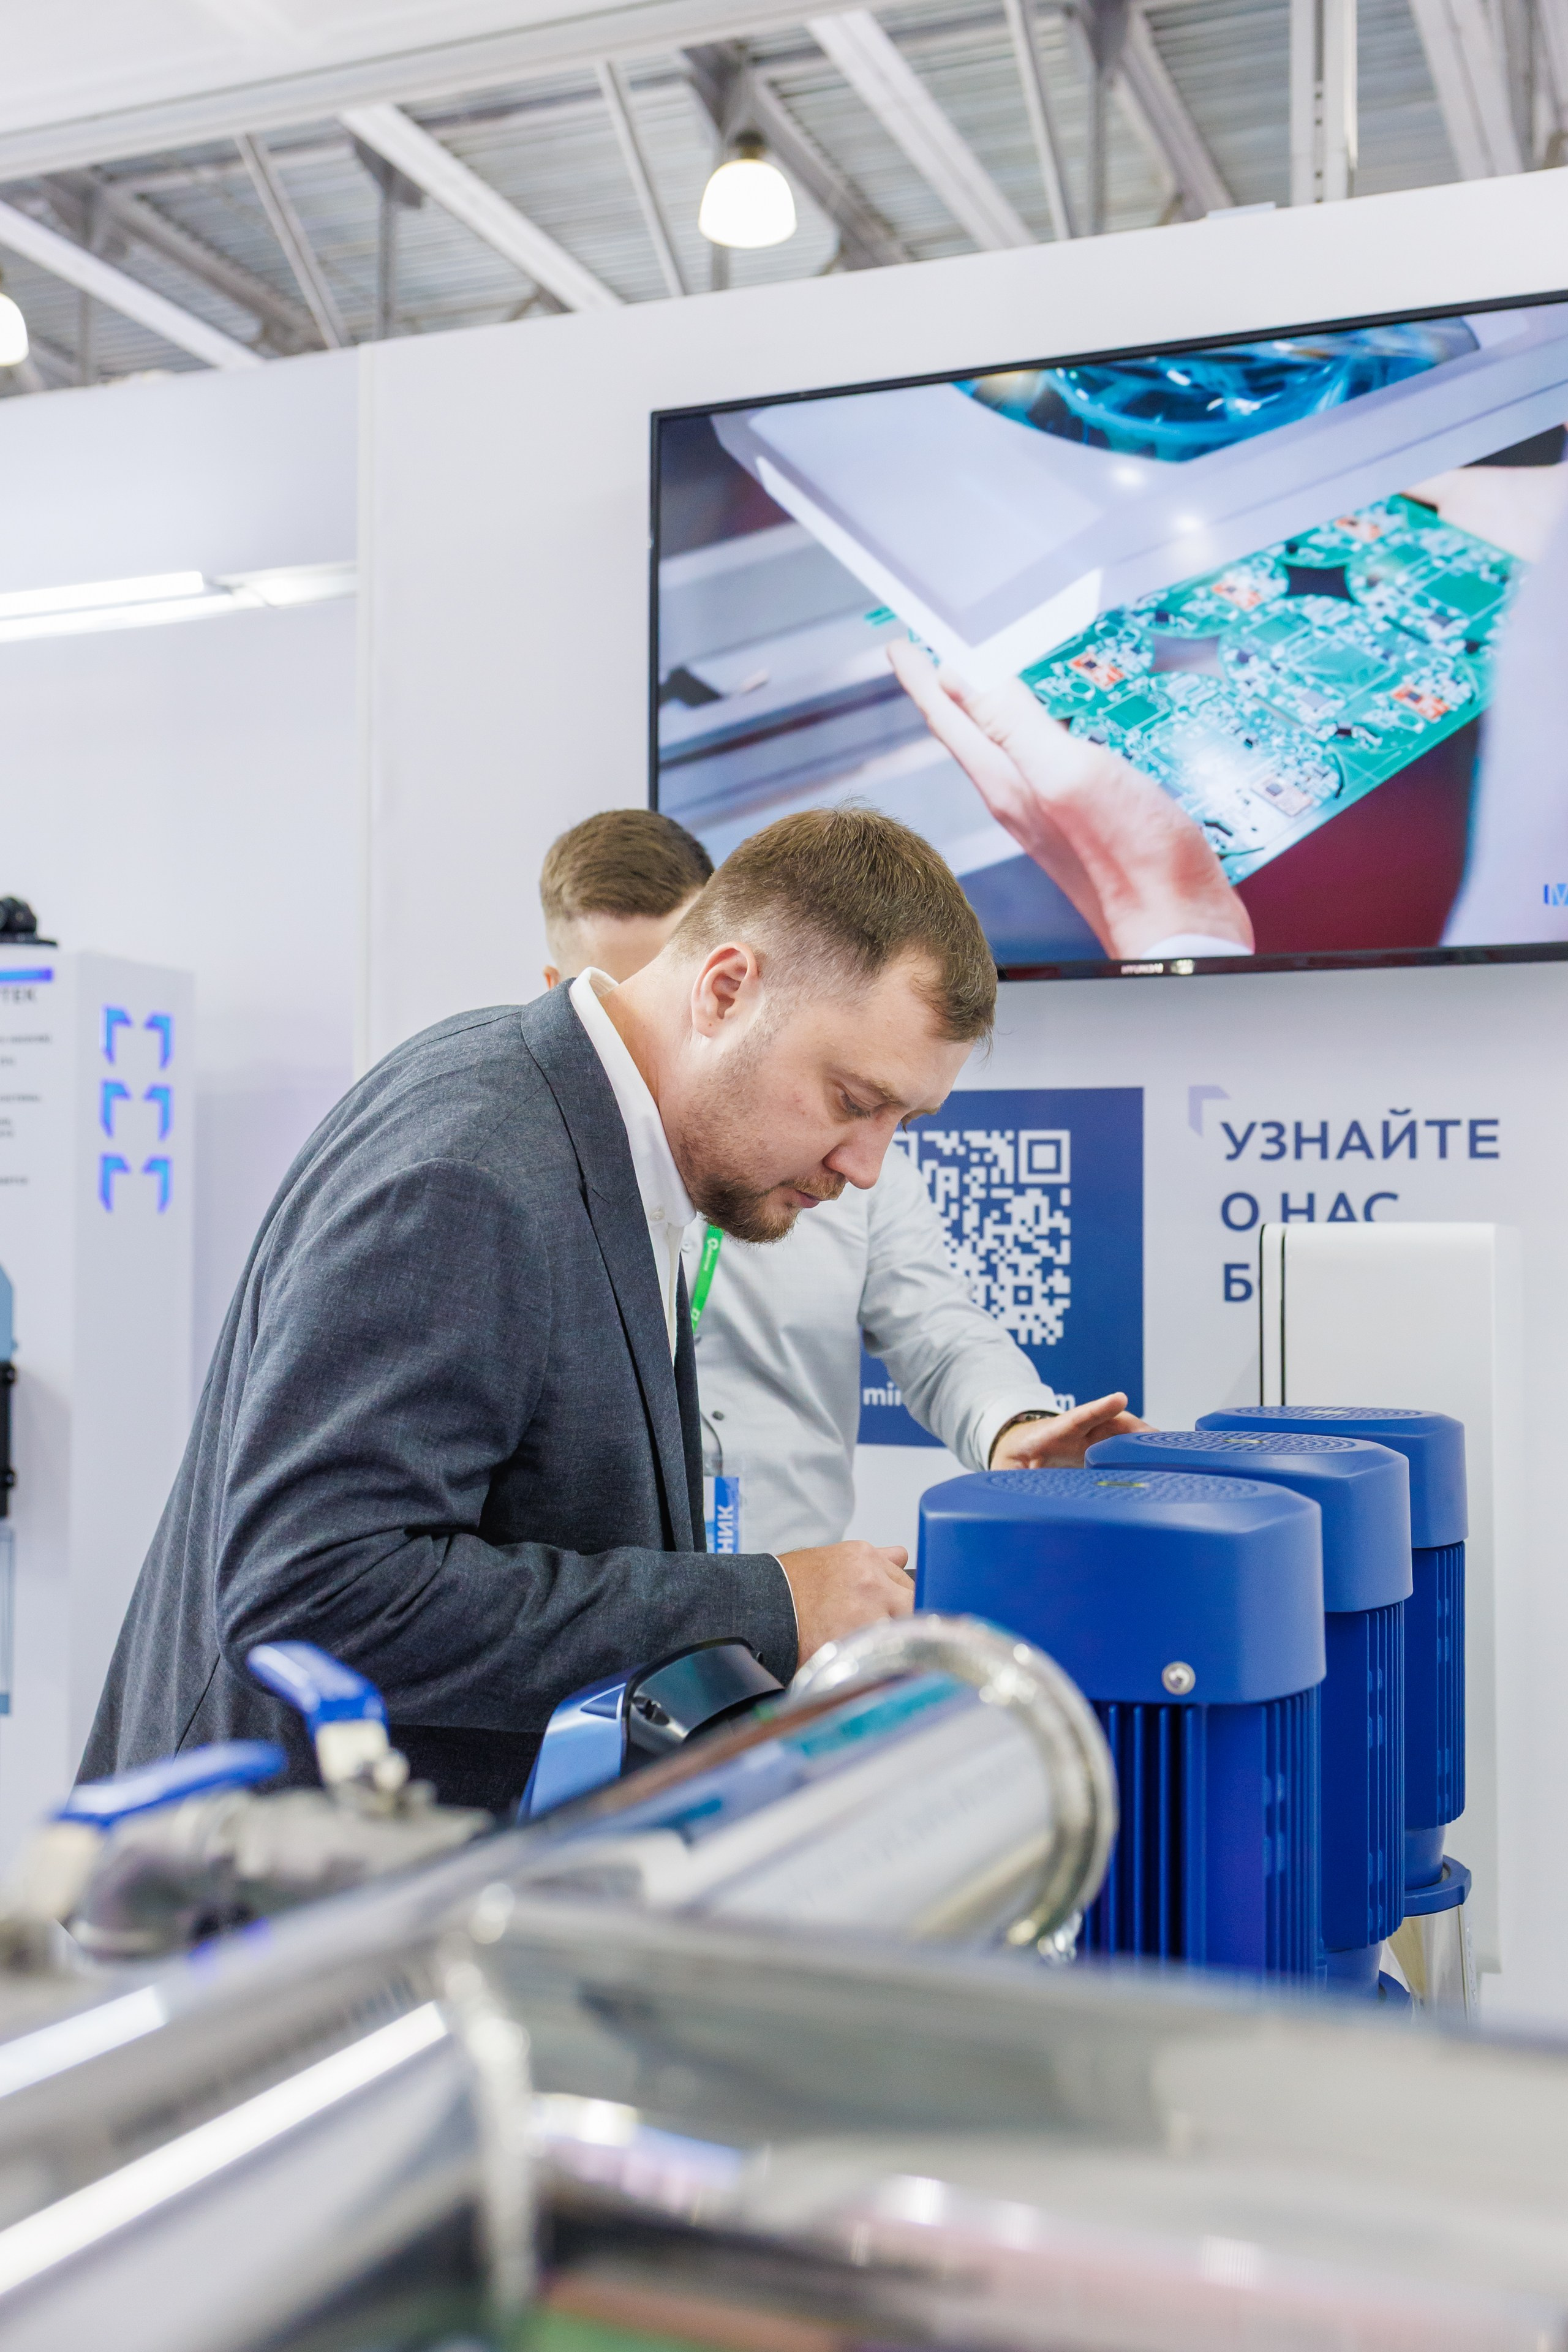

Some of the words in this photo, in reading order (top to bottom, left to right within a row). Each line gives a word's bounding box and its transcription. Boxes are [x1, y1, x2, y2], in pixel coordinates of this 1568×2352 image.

[1220, 1108, 1500, 1161] УЗНАЙТЕ
[1220, 1191, 1260, 1232] О
[1281, 1191, 1400, 1223] НАС
[1223, 1263, 1253, 1303] Б
